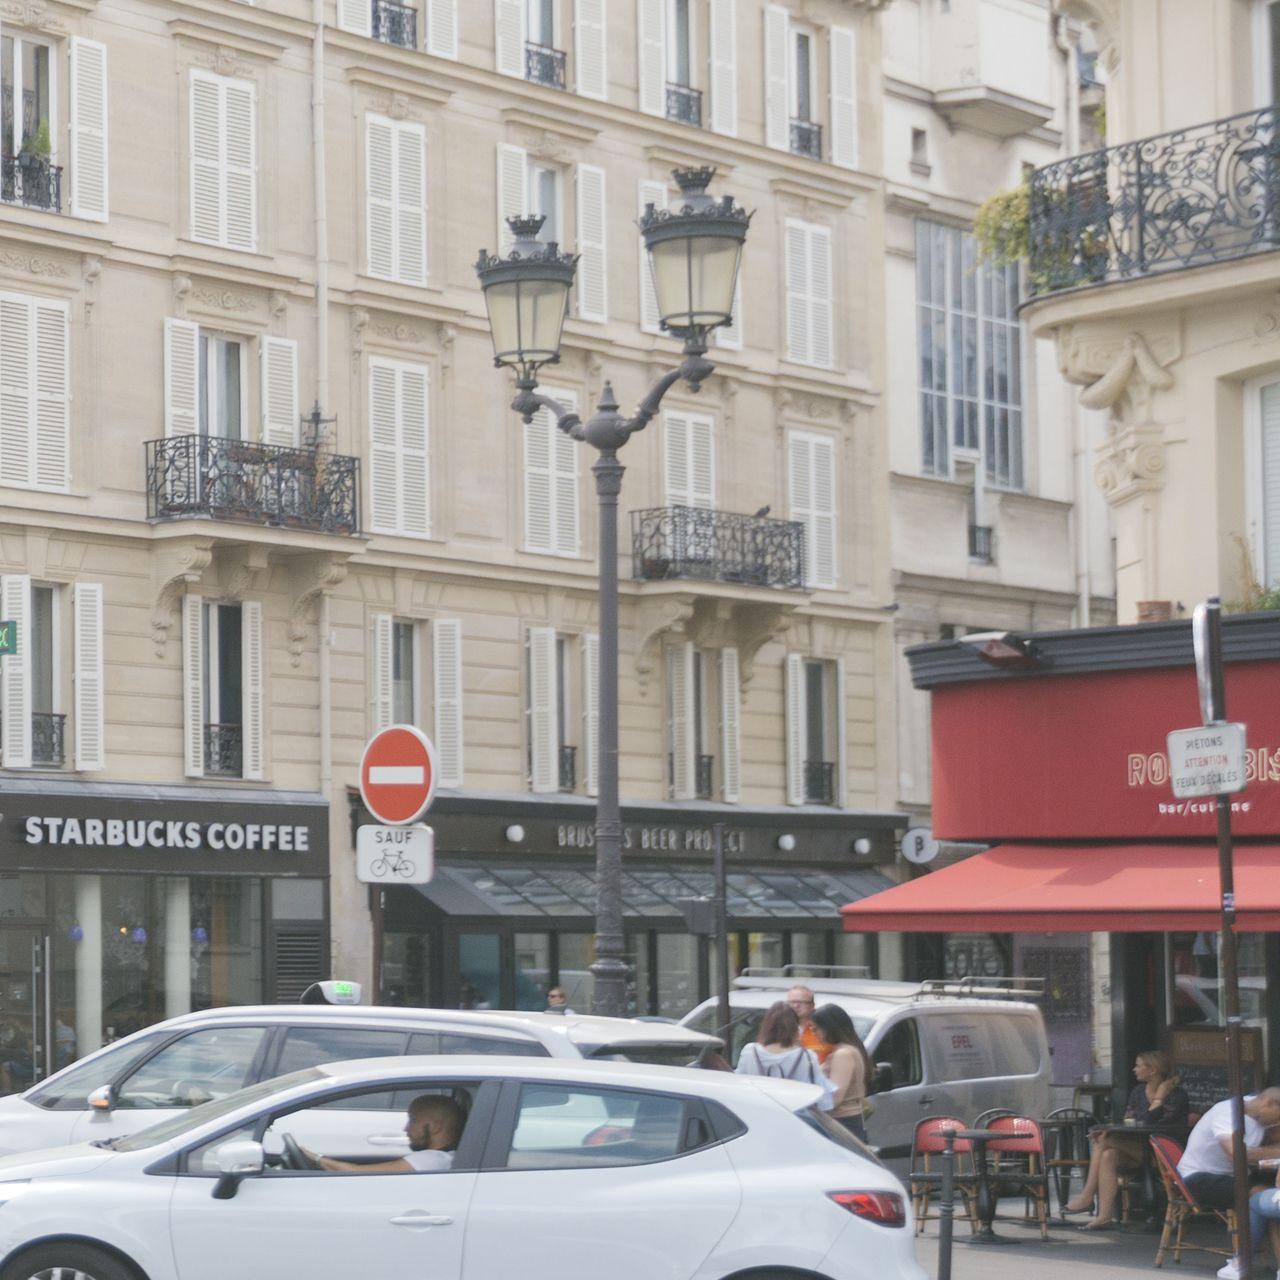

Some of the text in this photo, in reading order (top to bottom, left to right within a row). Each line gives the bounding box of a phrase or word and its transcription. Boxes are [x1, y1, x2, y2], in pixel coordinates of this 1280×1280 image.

[1184, 754, 1229, 769] ATTENTION
[25, 816, 309, 852] STARBUCKS COFFEE
[375, 830, 413, 844] SAUF
[557, 825, 633, 849] BRUSS
[641, 827, 677, 851] BEER
